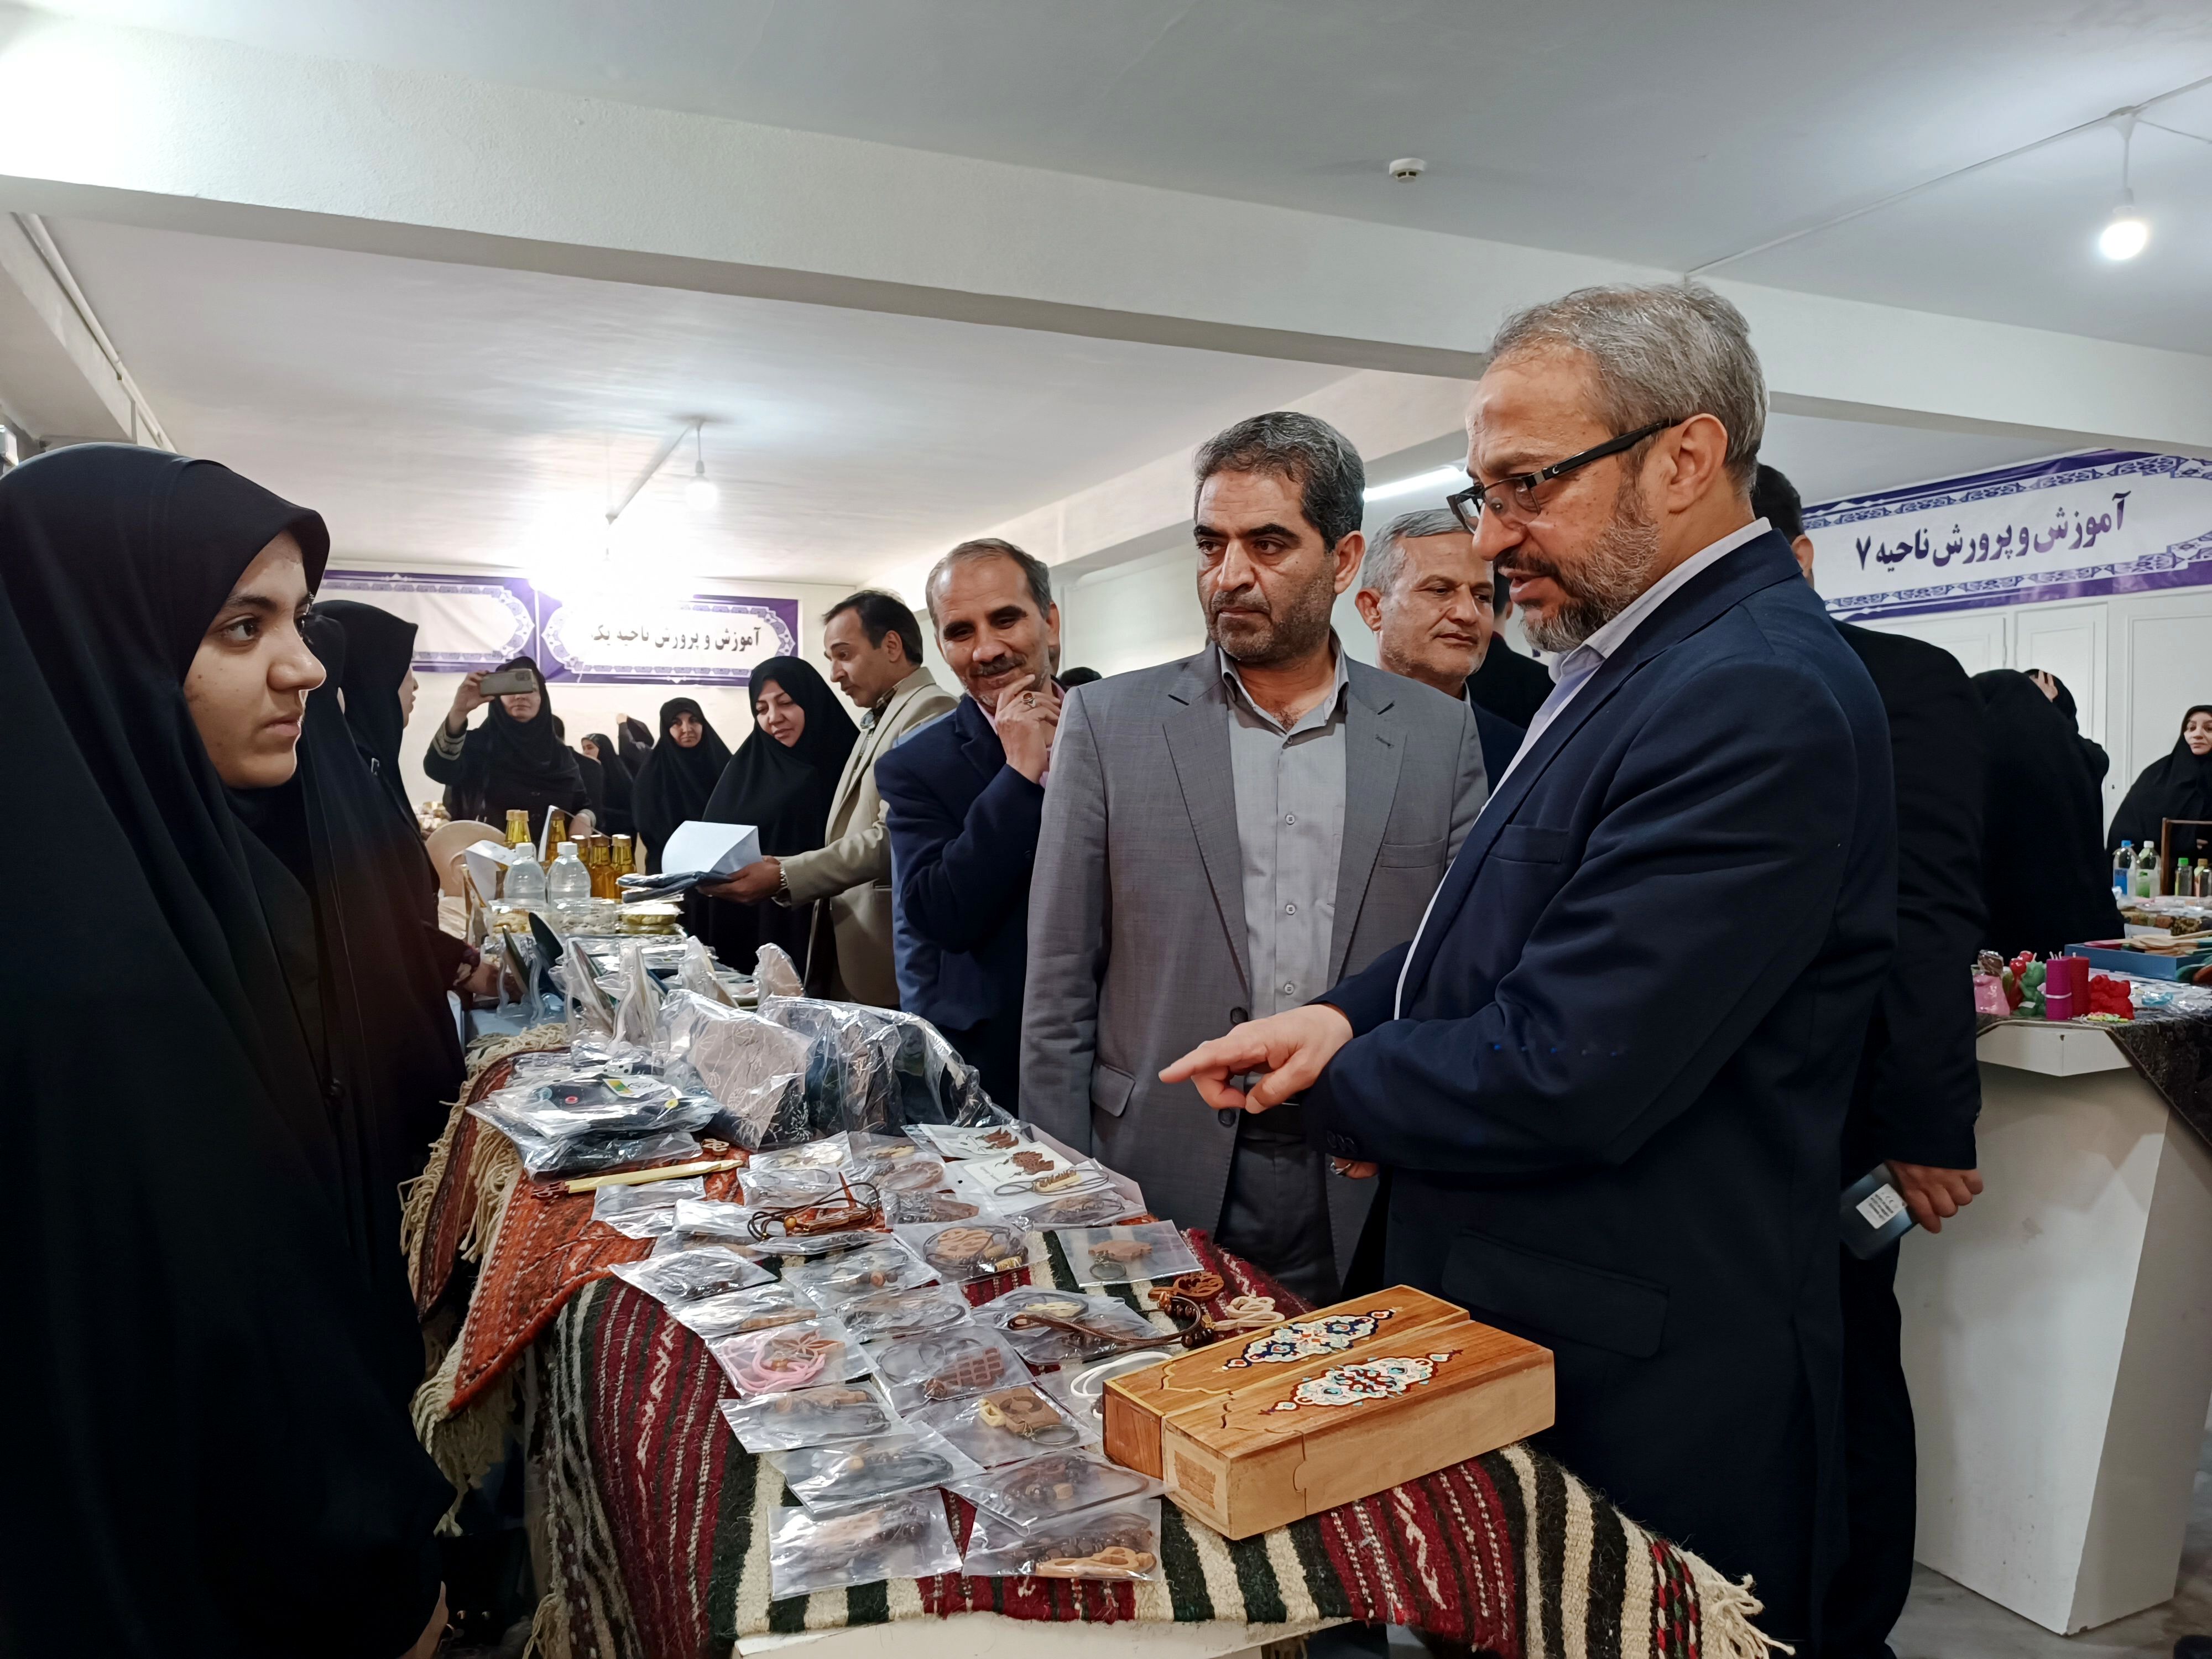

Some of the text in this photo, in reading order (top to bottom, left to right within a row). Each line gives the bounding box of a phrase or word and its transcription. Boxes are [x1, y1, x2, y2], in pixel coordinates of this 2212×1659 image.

[1855, 490, 2132, 572] آموزش و پرورش ناحیه ۷
[592, 624, 761, 651] آموزش و پرورش ناحیه یک
